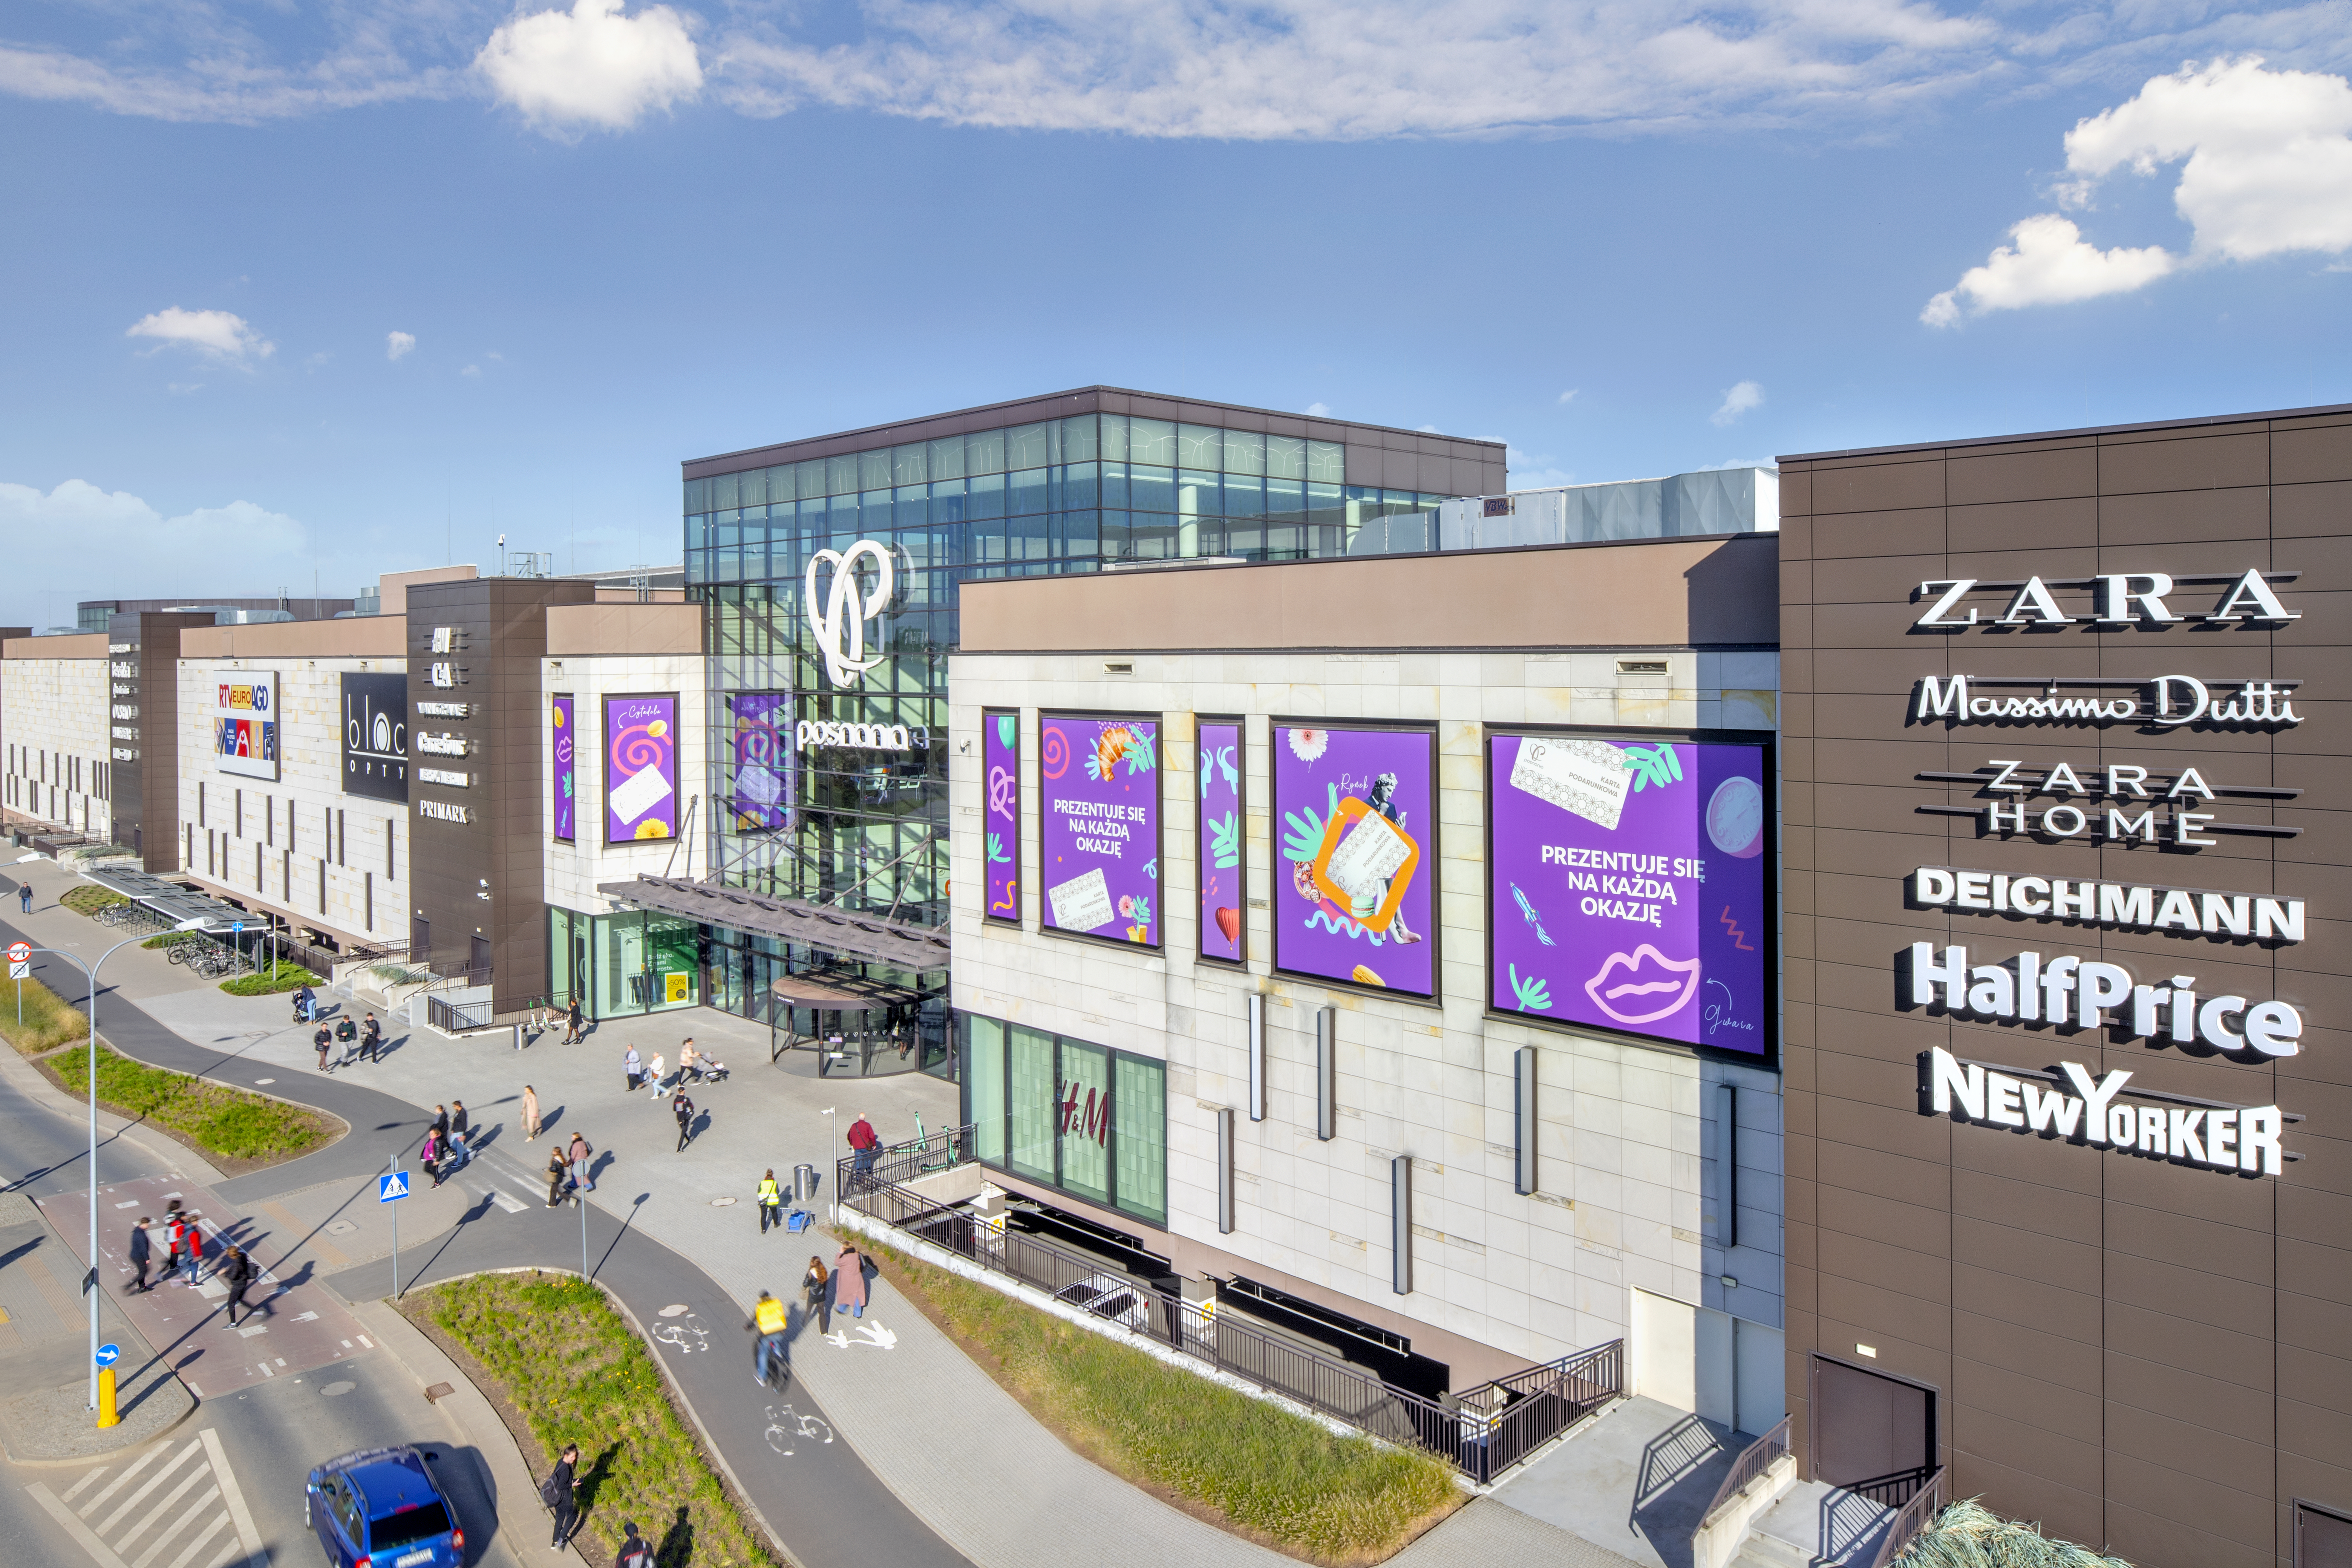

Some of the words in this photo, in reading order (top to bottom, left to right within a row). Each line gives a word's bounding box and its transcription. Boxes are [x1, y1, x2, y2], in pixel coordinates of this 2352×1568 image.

[1485, 500, 1506, 512] VBW
[1917, 568, 2302, 625] ZARA
[219, 684, 232, 708] RTV
[233, 691, 251, 704] EURO
[252, 685, 268, 711] AGD
[1918, 674, 2137, 721] Massimo
[2150, 674, 2305, 724] Dutti
[629, 705, 661, 719] Cytadela
[417, 732, 466, 756] Carrefour
[797, 720, 909, 751] posnania
[1524, 758, 1544, 769] posnania
[419, 768, 438, 782] LEROY
[440, 771, 468, 786] MERLIN
[1341, 773, 1369, 794] Rynek
[1568, 772, 1618, 798] PODARUNKOWA
[1600, 776, 1620, 789] KARTA
[1988, 760, 2215, 799] ZARA
[420, 800, 467, 824] PRIMARK
[1054, 799, 1125, 820] PREZENTUJE
[1127, 806, 1145, 825] SIĘ
[1989, 801, 2217, 845] HOME
[1069, 818, 1087, 833] NA
[1089, 819, 1130, 842] KAŻDĄ
[1374, 830, 1387, 844] KARTA
[1076, 837, 1121, 859] OKAZJĘ
[1363, 835, 1391, 868] PODARUNKOWA
[1542, 845, 1668, 876] PREZENTUJE
[1673, 858, 1705, 883] SIĘ
[1568, 871, 1599, 893] NA
[1603, 873, 1677, 905] KAŻDĄ
[1080, 897, 1106, 909] PODARUNKOWA
[1580, 897, 1661, 928] OKAZJĘ
[1917, 867, 2305, 941] DEICHMANN
[1913, 941, 2303, 1057] HalfPrice
[1705, 1004, 1754, 1034] Gwara
[1052, 1080, 1108, 1148] H&M
